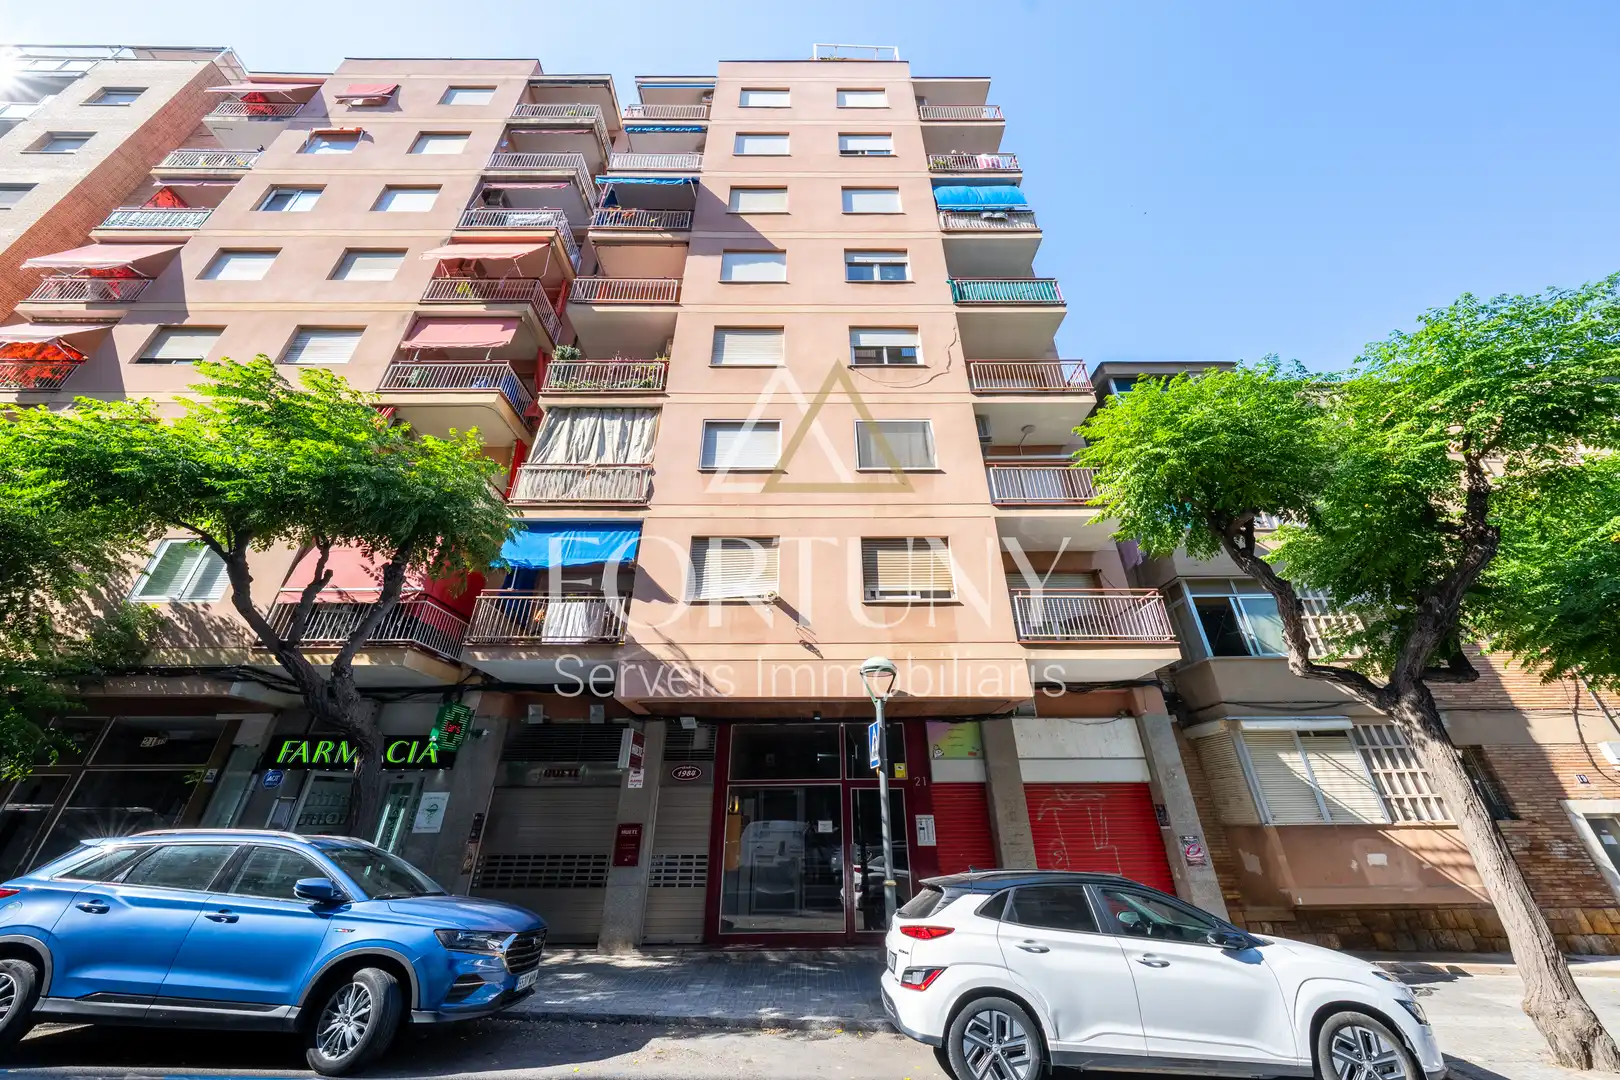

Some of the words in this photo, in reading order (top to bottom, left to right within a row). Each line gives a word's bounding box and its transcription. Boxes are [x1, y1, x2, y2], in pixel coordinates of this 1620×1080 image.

[276, 740, 438, 764] FARMCIA
[677, 768, 698, 778] 1984
[914, 776, 927, 787] 21
